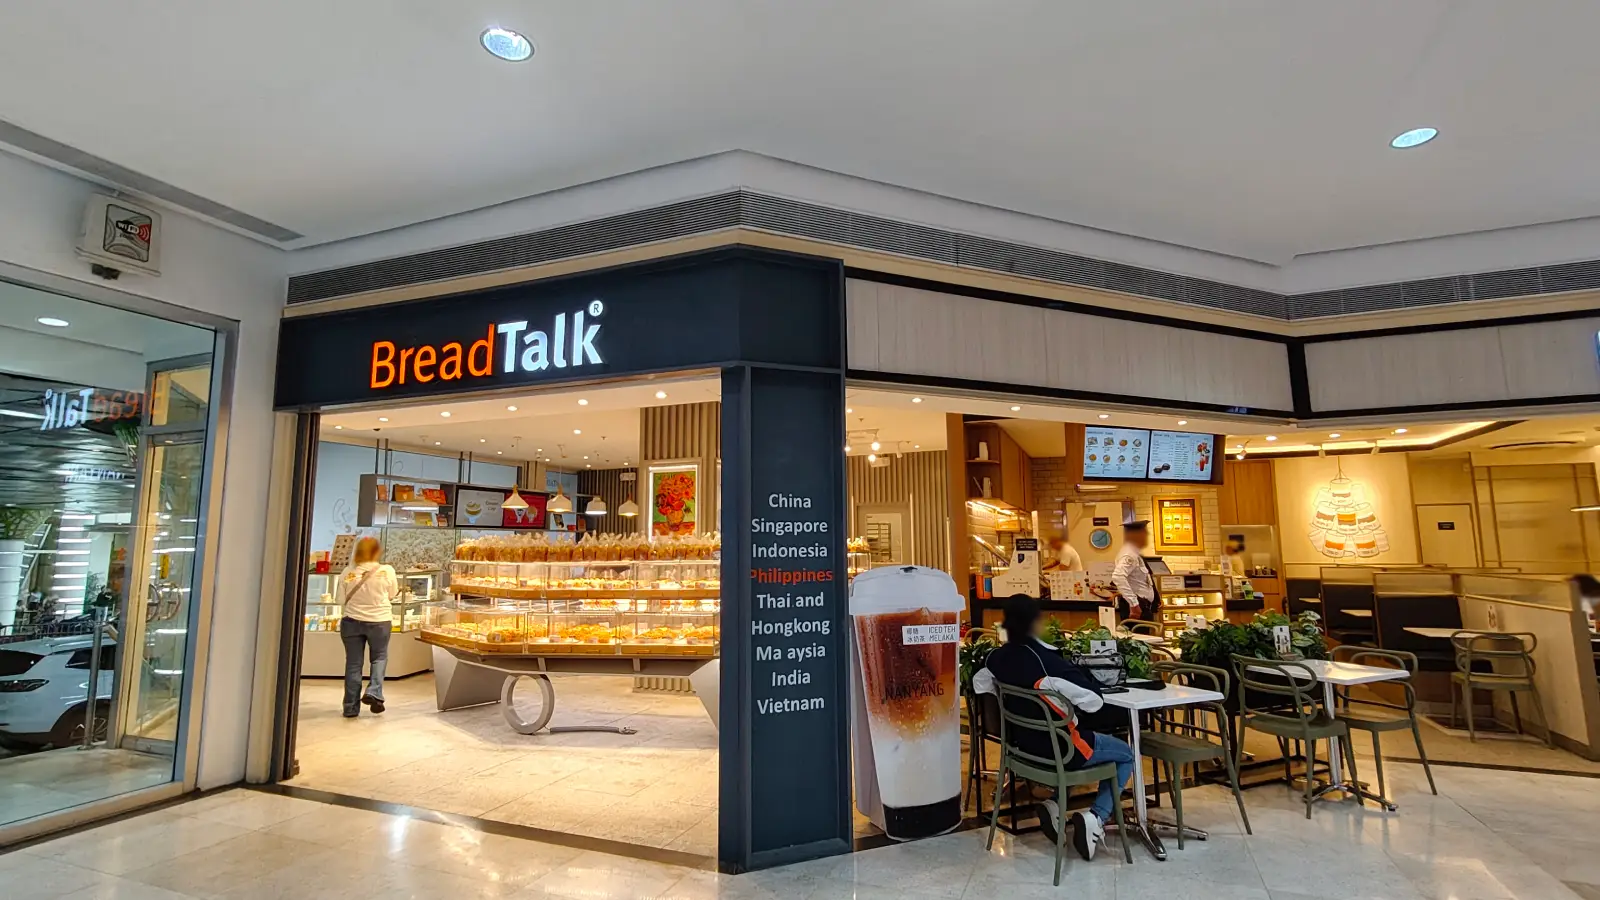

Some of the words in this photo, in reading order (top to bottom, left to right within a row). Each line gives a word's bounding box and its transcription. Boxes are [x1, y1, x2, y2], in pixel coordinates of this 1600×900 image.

[768, 493, 812, 508] China
[751, 518, 828, 536] Singapore
[752, 542, 828, 558] Indonesia
[751, 617, 831, 637] Hongkong
[928, 626, 943, 634] ICED
[944, 625, 956, 633] TEH
[929, 634, 955, 642] MELAKA
[771, 669, 811, 687] India
[885, 682, 945, 701] NANYANG
[757, 697, 825, 715] Vietnam
